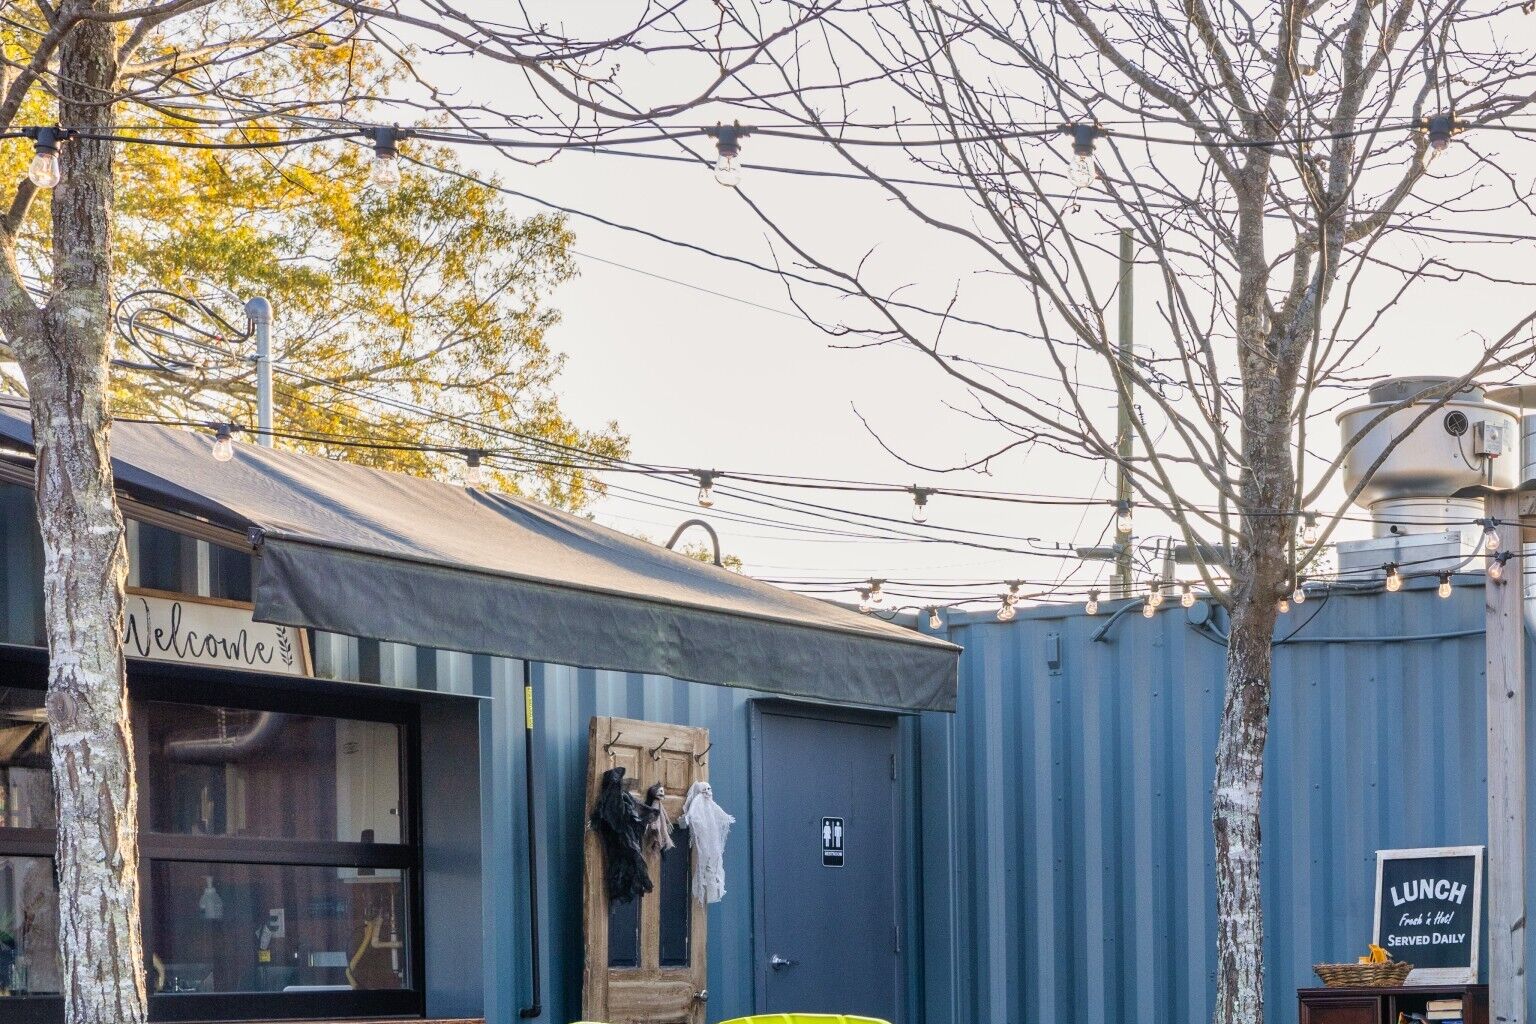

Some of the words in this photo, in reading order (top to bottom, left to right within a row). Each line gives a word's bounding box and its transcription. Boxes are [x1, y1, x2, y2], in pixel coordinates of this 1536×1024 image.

[1390, 878, 1468, 907] LUNCH
[1399, 912, 1423, 927] Fresh
[1433, 910, 1455, 925] Hot!
[1387, 933, 1430, 947] SERVED
[1432, 932, 1466, 945] DAILY
